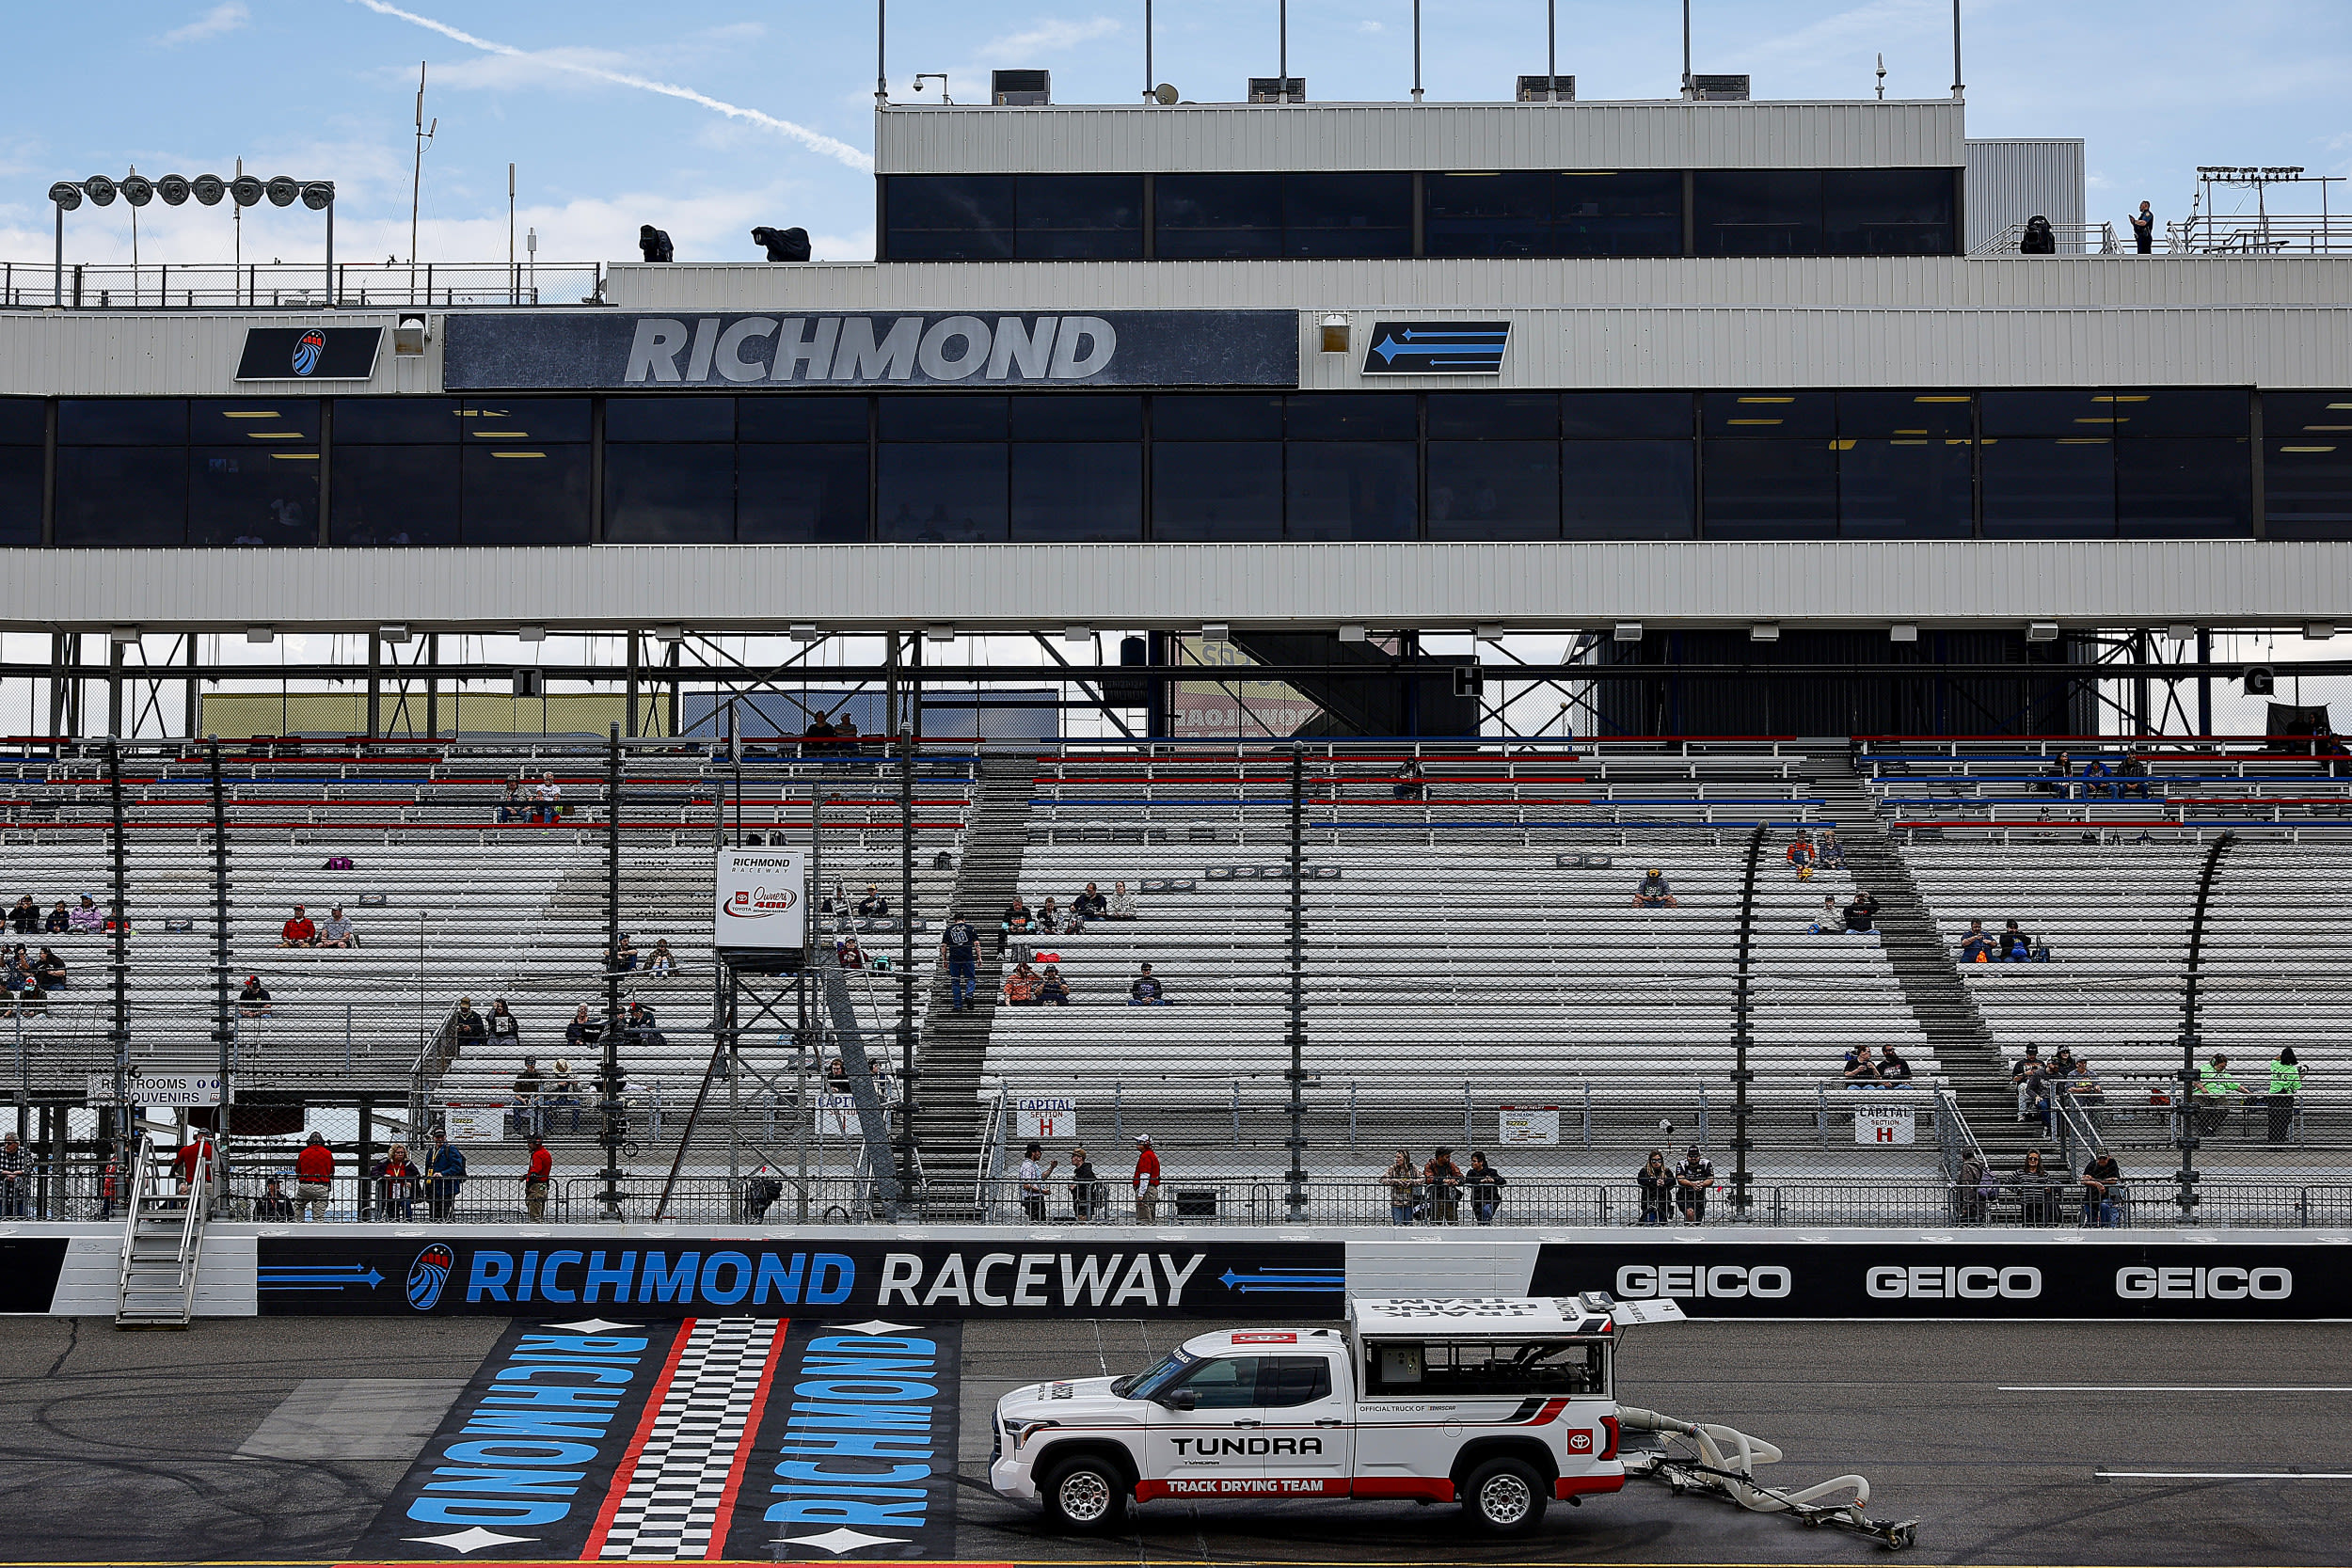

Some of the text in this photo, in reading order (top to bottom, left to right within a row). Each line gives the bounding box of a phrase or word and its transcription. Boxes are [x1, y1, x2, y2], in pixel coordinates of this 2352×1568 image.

[624, 315, 1117, 382] RICHMOND
[519, 670, 536, 696] I
[1454, 667, 1483, 696] H
[2245, 667, 2274, 695] G
[733, 858, 790, 867] RICHMOND
[754, 886, 787, 901] Owners
[1019, 1099, 1073, 1111] CAPITAL
[1859, 1107, 1911, 1117] CAPITAL
[1040, 1118, 1053, 1136] H
[1876, 1127, 1893, 1143] H
[466, 1250, 1207, 1307] RICHMOND RACEWAY
[1615, 1265, 1792, 1299] GEICO
[1866, 1266, 2042, 1299] GEICO
[2116, 1266, 2293, 1300] GEICO
[406, 1334, 650, 1526] RICHMOND
[763, 1336, 939, 1527] RICHMOND
[1169, 1437, 1323, 1455] TUNDRA
[1167, 1480, 1324, 1493] TRACK DRYING TEAM
